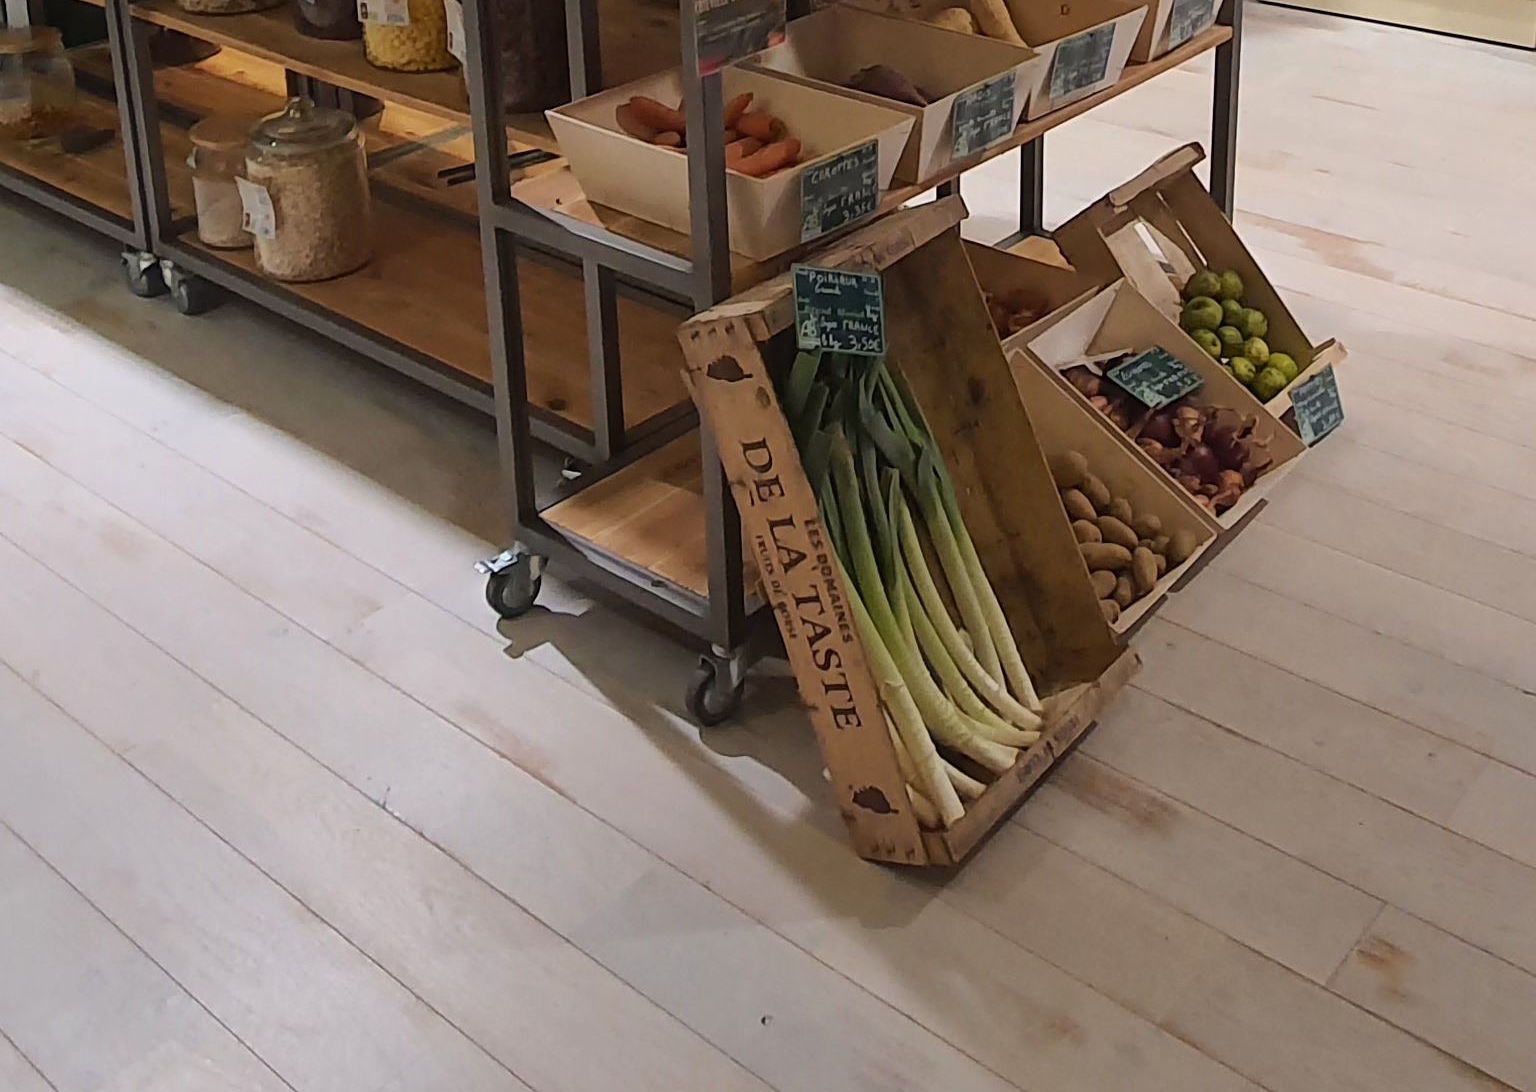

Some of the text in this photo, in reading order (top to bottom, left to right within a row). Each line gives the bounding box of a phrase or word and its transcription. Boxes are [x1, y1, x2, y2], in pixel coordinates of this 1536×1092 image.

[739, 436, 864, 731] DE LA TASTE
[804, 517, 854, 644] LES DOMAINES
